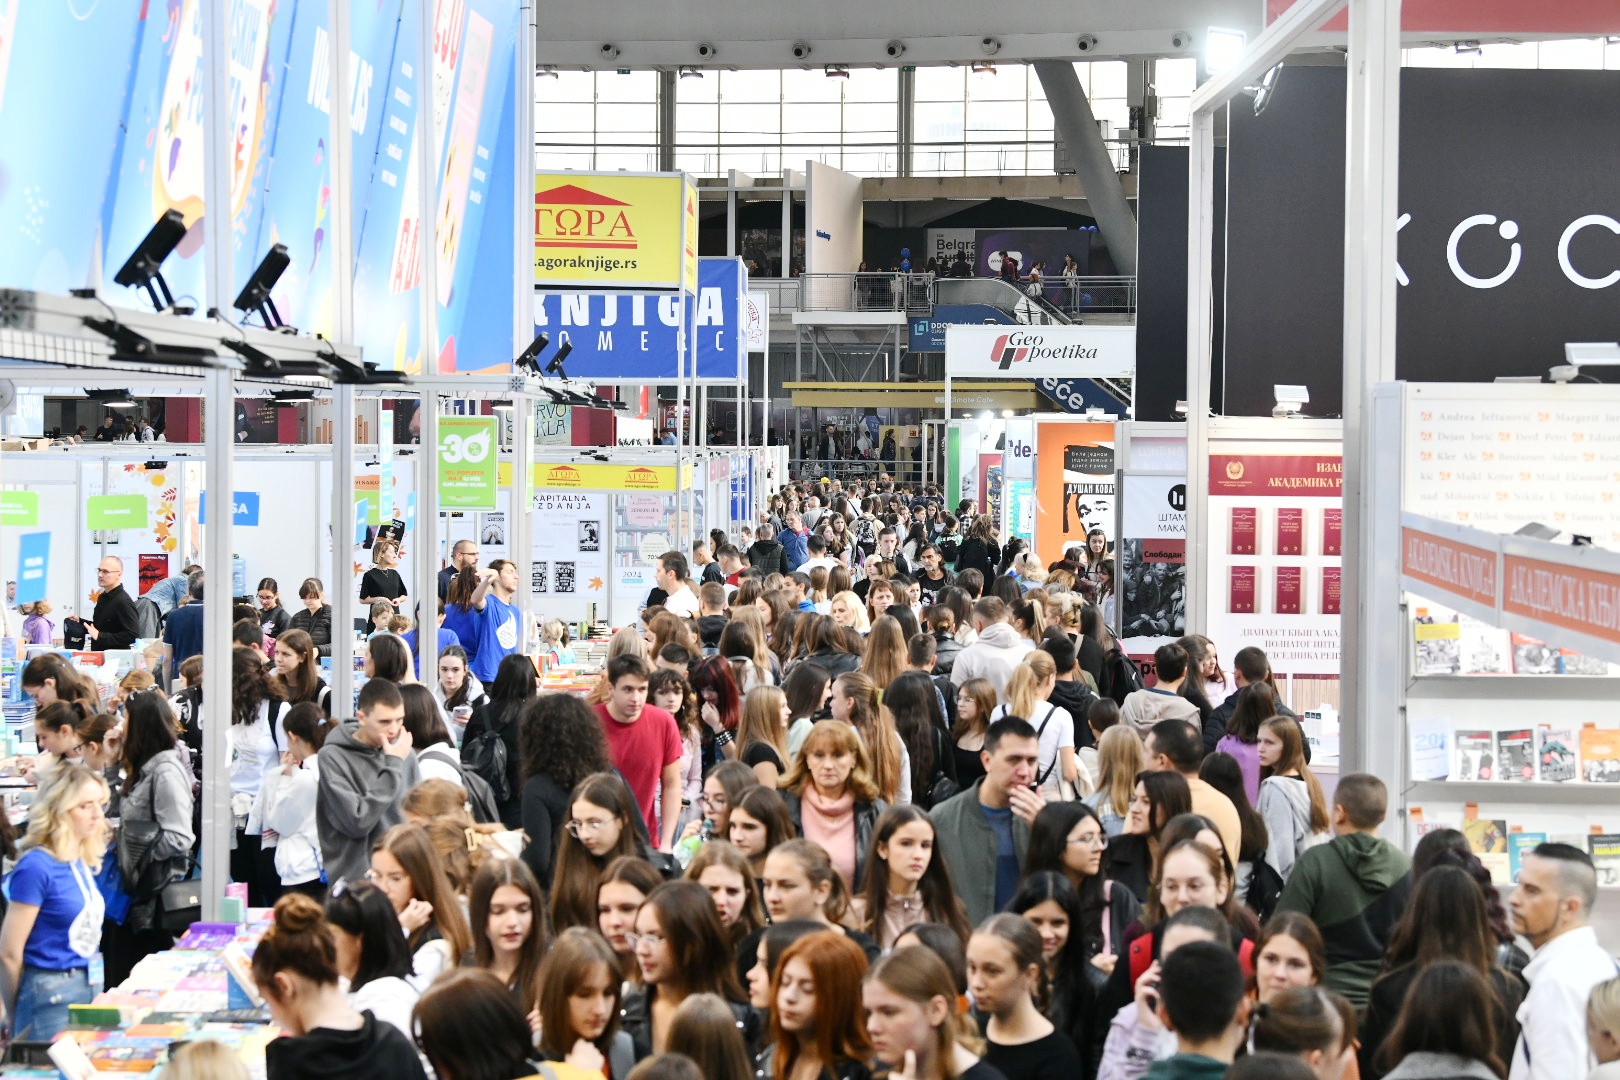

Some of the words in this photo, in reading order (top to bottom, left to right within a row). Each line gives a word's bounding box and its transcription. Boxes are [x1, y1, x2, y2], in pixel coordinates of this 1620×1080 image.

[1009, 331, 1044, 346] Geo
[1027, 344, 1098, 362] poetika
[1042, 377, 1084, 410] eće
[1439, 412, 1474, 422] Andrea
[1555, 412, 1599, 424] Margerit
[1438, 432, 1464, 442] Dejan
[1268, 477, 1334, 488] АКАДЕМИКА
[1067, 484, 1093, 496] ДУШАН
[1144, 550, 1182, 559] Слободан
